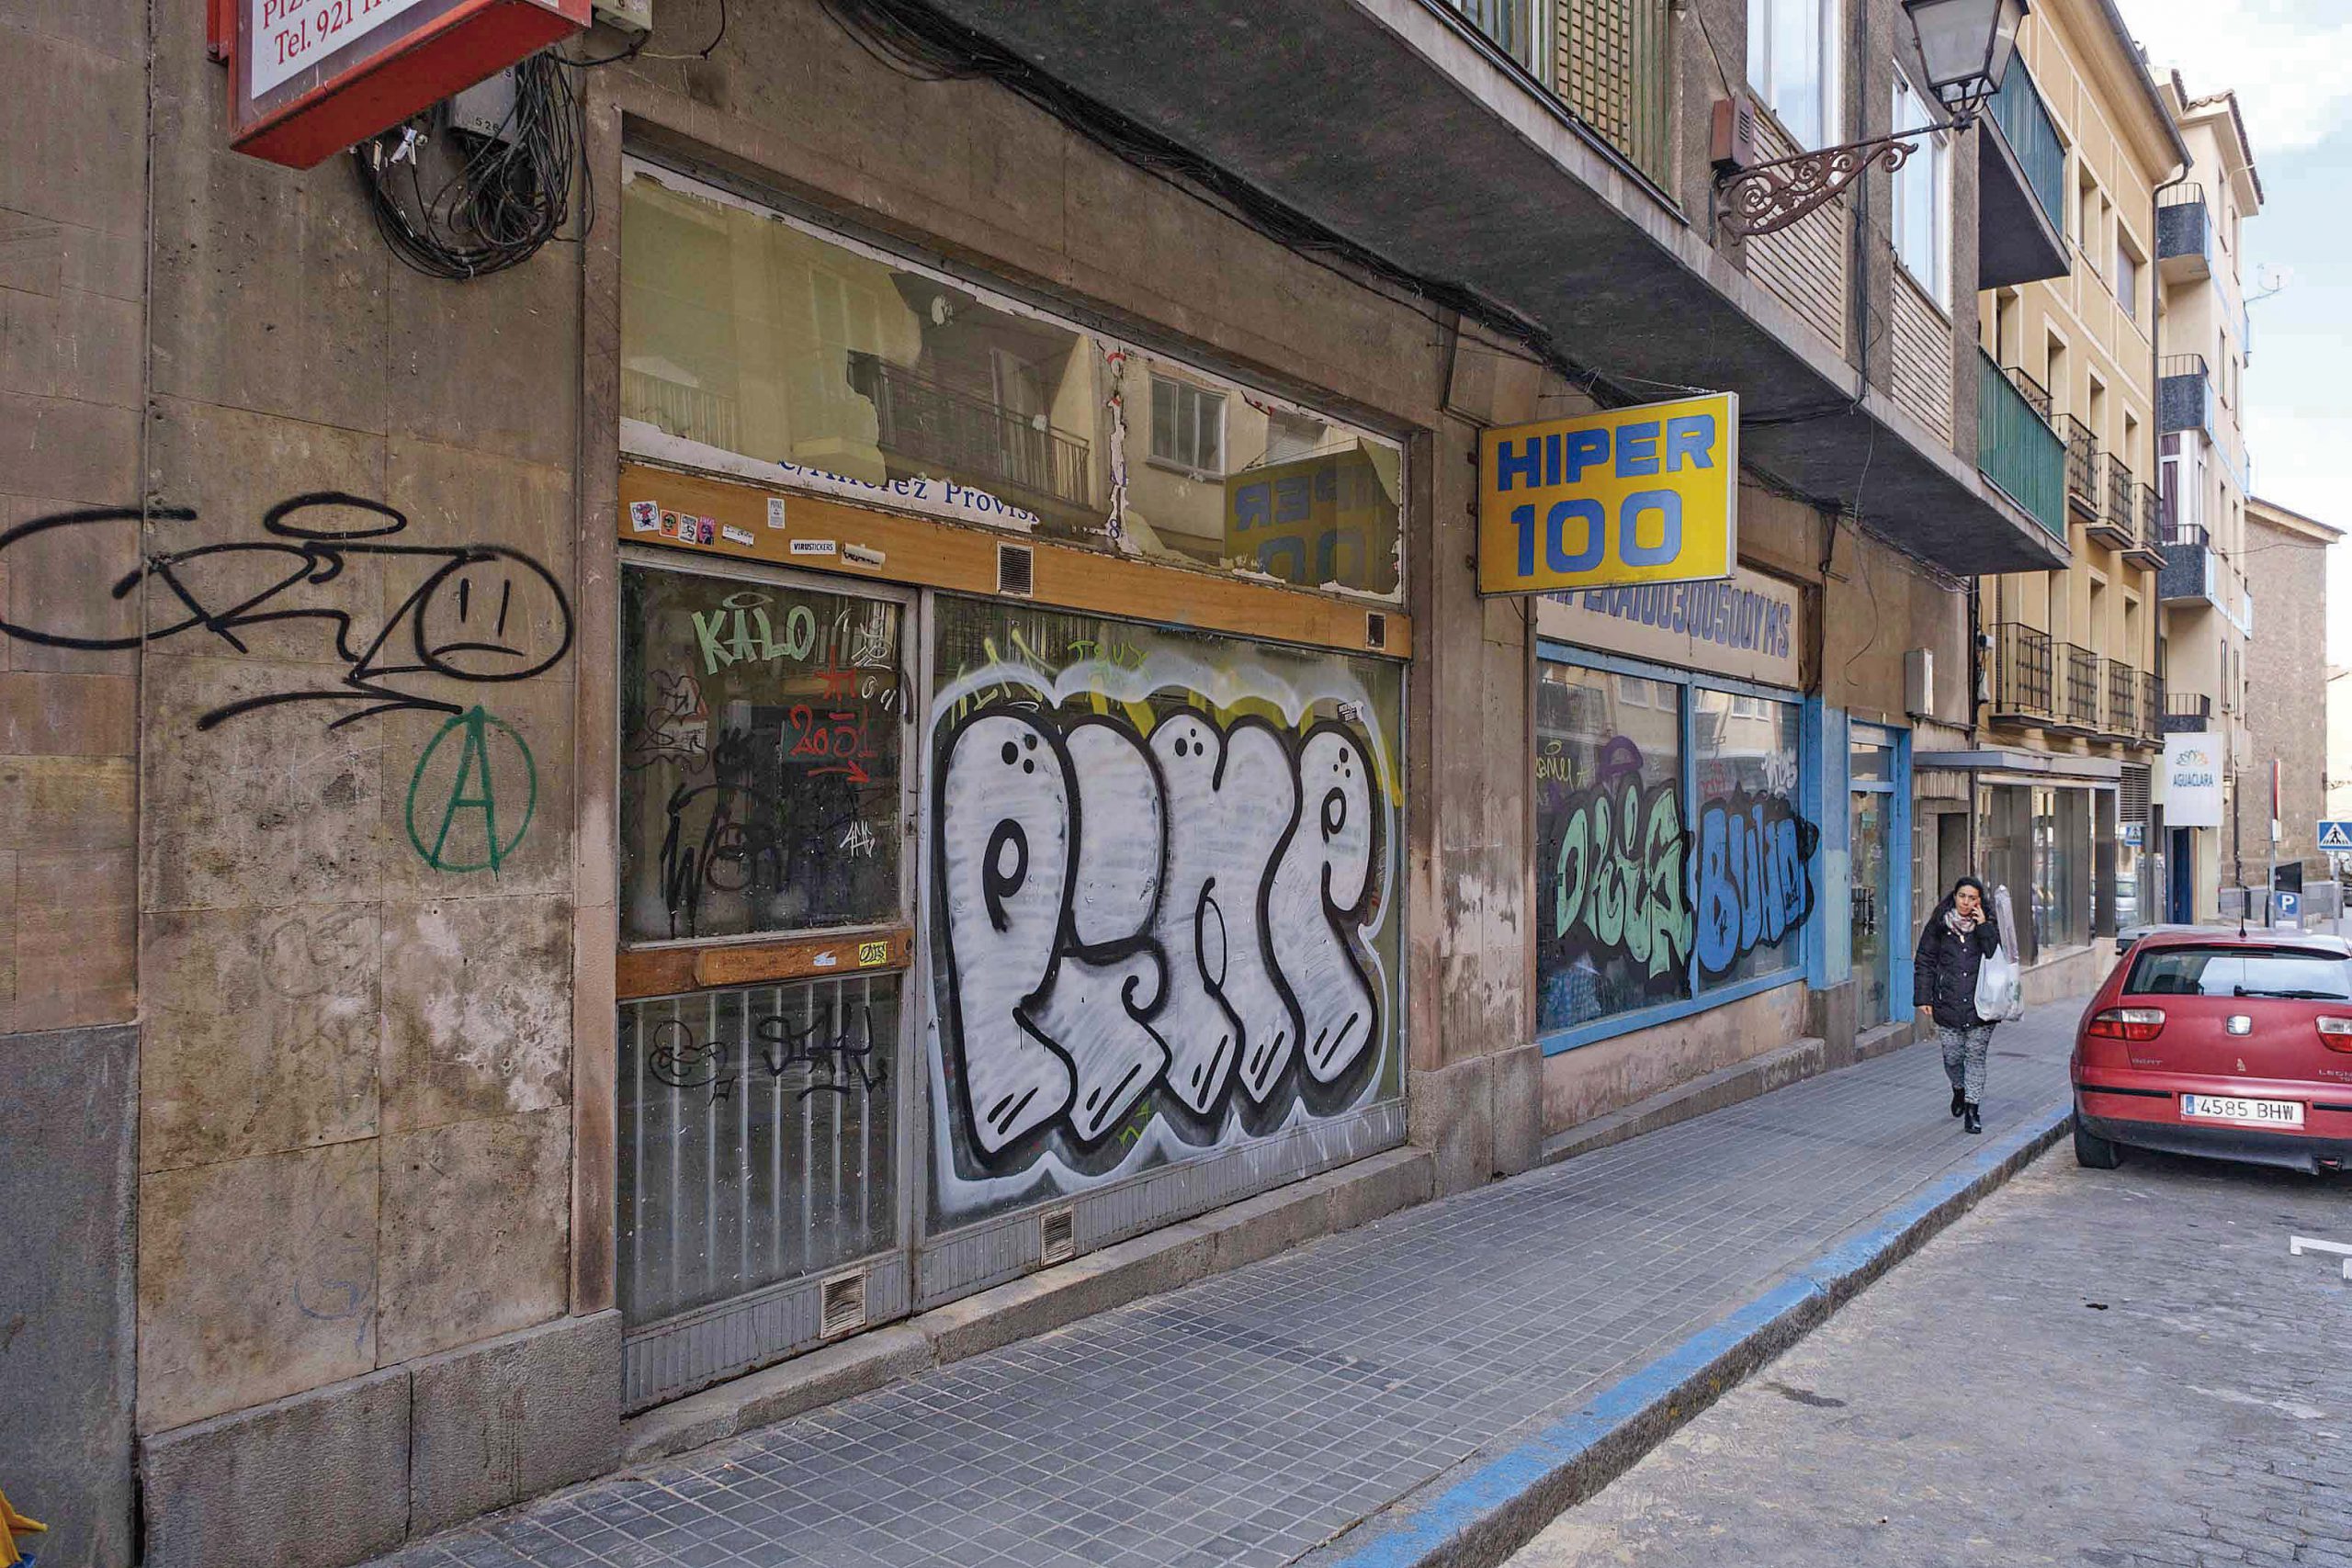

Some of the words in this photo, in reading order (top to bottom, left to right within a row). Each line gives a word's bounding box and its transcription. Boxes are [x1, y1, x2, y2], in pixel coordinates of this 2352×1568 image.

[274, 18, 311, 65] Tel.
[1498, 413, 1716, 491] HIPER
[794, 543, 834, 552] VIRUSTICKERS
[1510, 489, 1682, 577] 100
[2281, 894, 2295, 911] P
[2200, 1099, 2248, 1117] 4585
[2257, 1102, 2294, 1121] BHW
